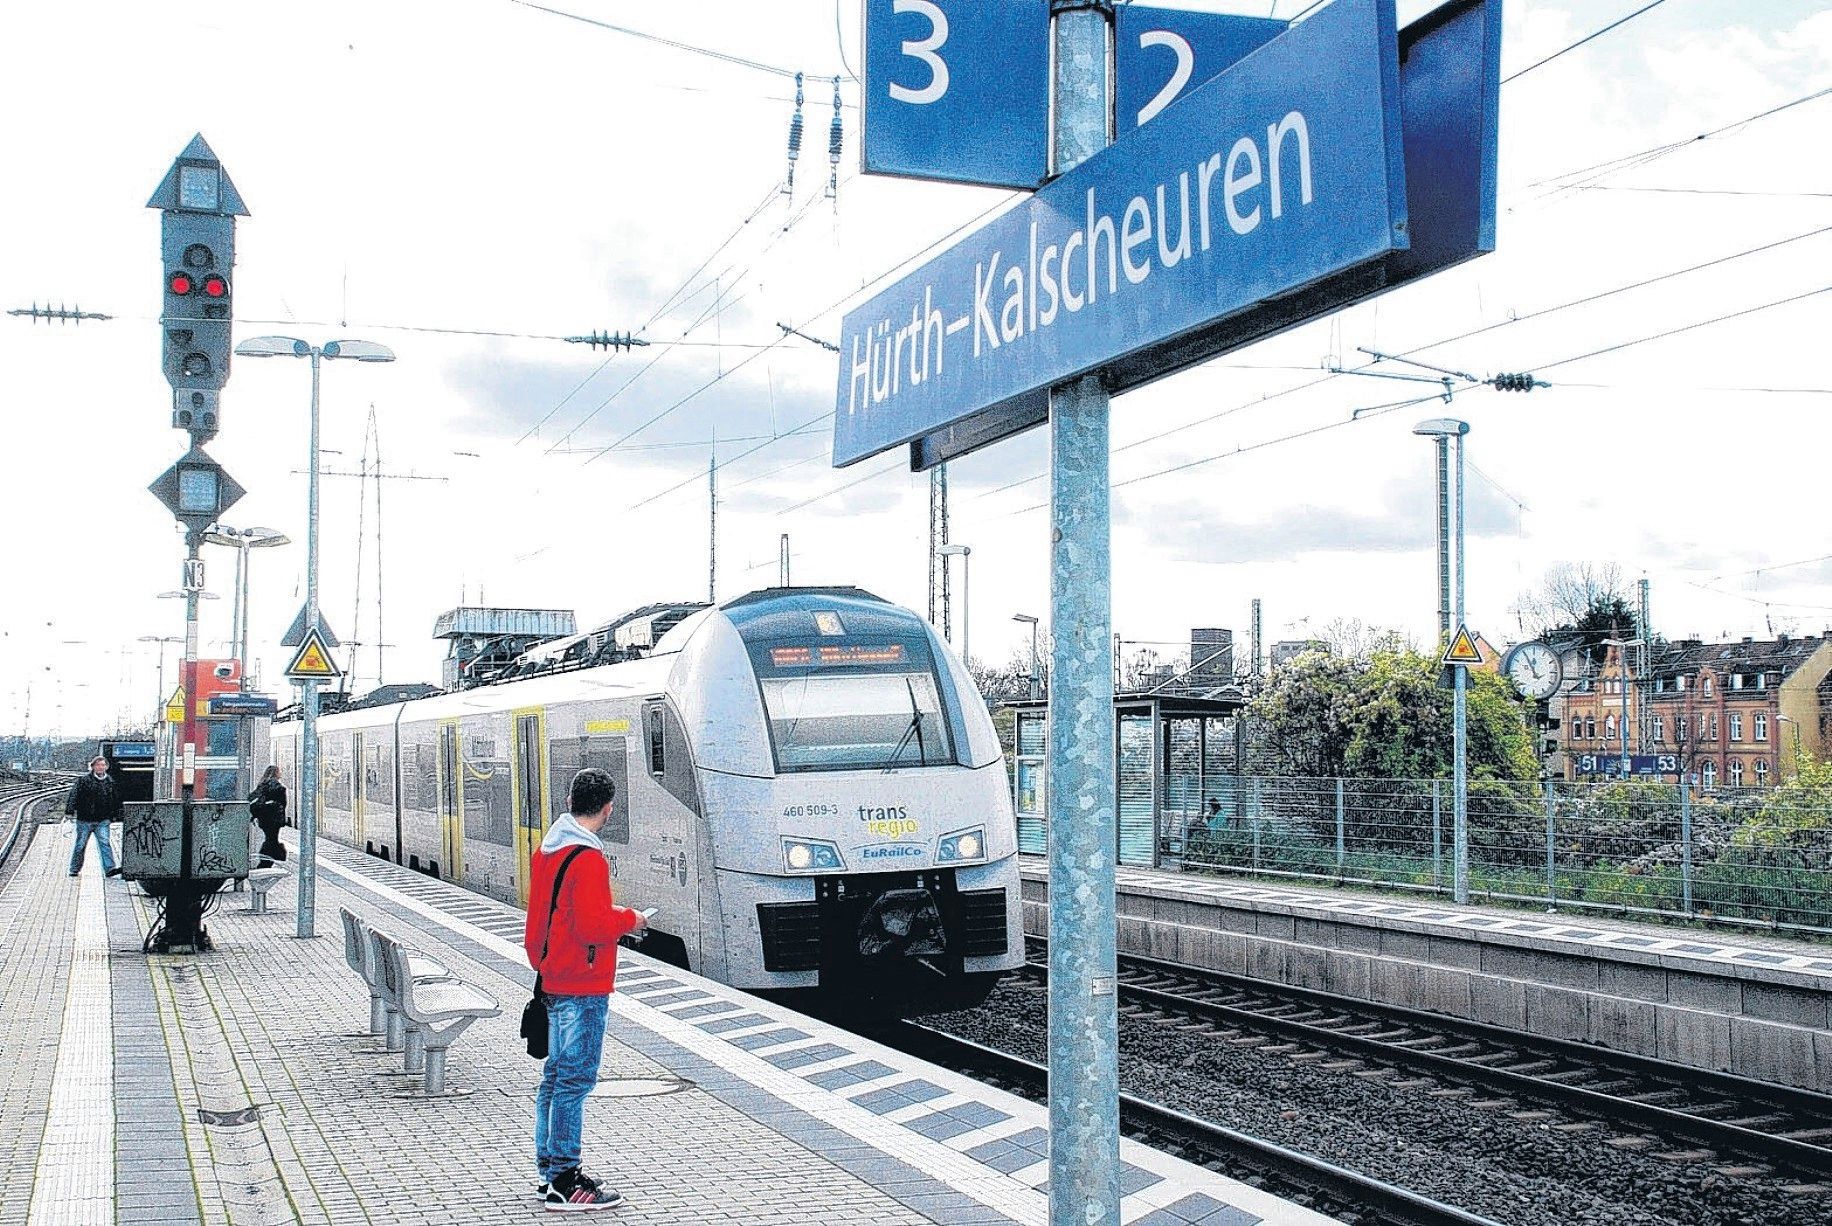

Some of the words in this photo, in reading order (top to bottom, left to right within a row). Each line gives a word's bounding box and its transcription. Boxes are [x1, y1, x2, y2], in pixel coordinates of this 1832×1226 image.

[888, 0, 950, 104] 3
[1137, 30, 1195, 127] 2
[848, 109, 1314, 415] Hürth-Kalscheuren
[183, 561, 205, 588] N3
[1582, 755, 1597, 771] 51
[1658, 755, 1676, 771] 53
[783, 805, 804, 818] 460
[806, 804, 838, 817] 509-3
[857, 804, 908, 822] trans
[869, 819, 918, 839] regio
[862, 846, 922, 859] EuRailCo
